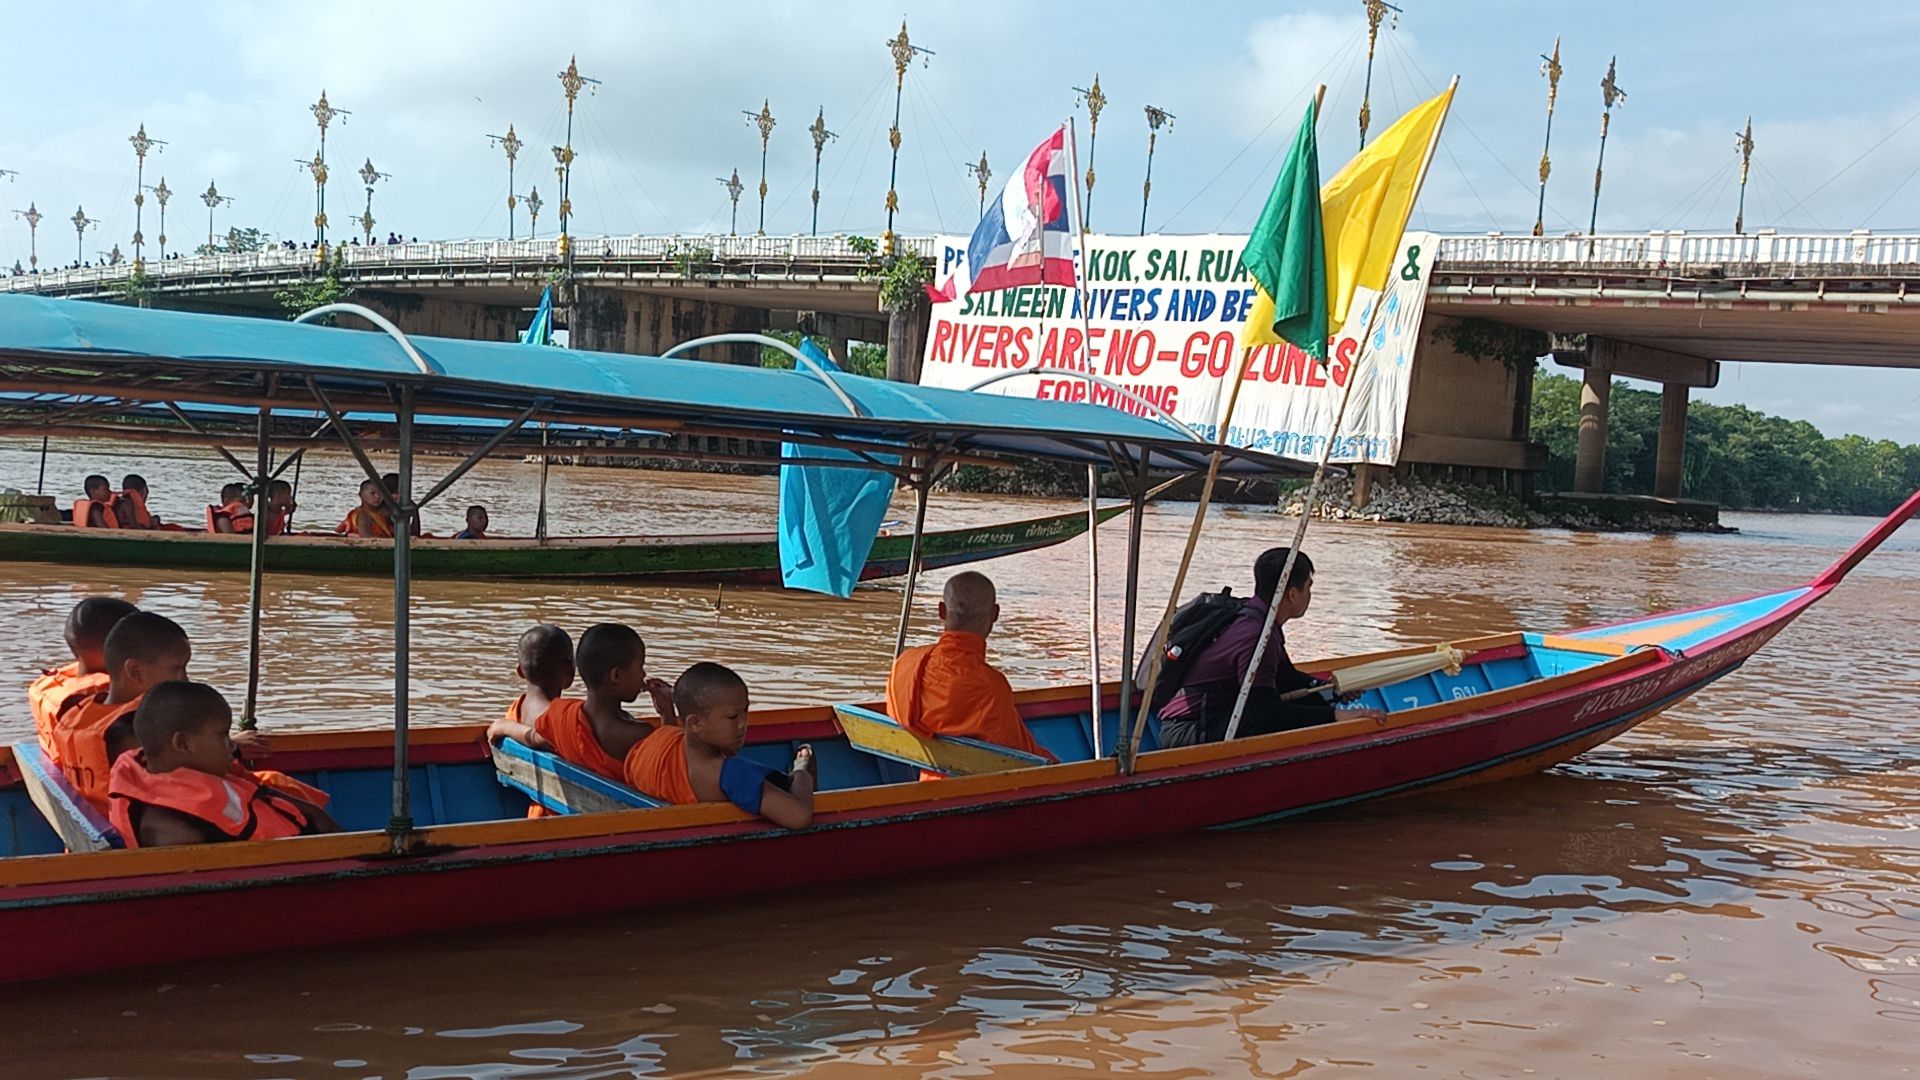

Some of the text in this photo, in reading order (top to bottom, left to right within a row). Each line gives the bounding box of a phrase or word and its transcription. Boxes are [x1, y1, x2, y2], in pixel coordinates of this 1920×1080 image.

[1088, 249, 1140, 284] KOK,
[1144, 249, 1191, 282] SAI,
[1197, 249, 1253, 282] RUA
[1401, 245, 1420, 281] &
[960, 287, 1066, 318] SALWEEN
[1071, 287, 1162, 321] RIVERS
[1165, 289, 1216, 322] AND
[930, 319, 1033, 369] RIVERS
[1037, 327, 1106, 375] ARE
[1104, 328, 1235, 379] NO-GO
[1090, 382, 1178, 417] MINING
